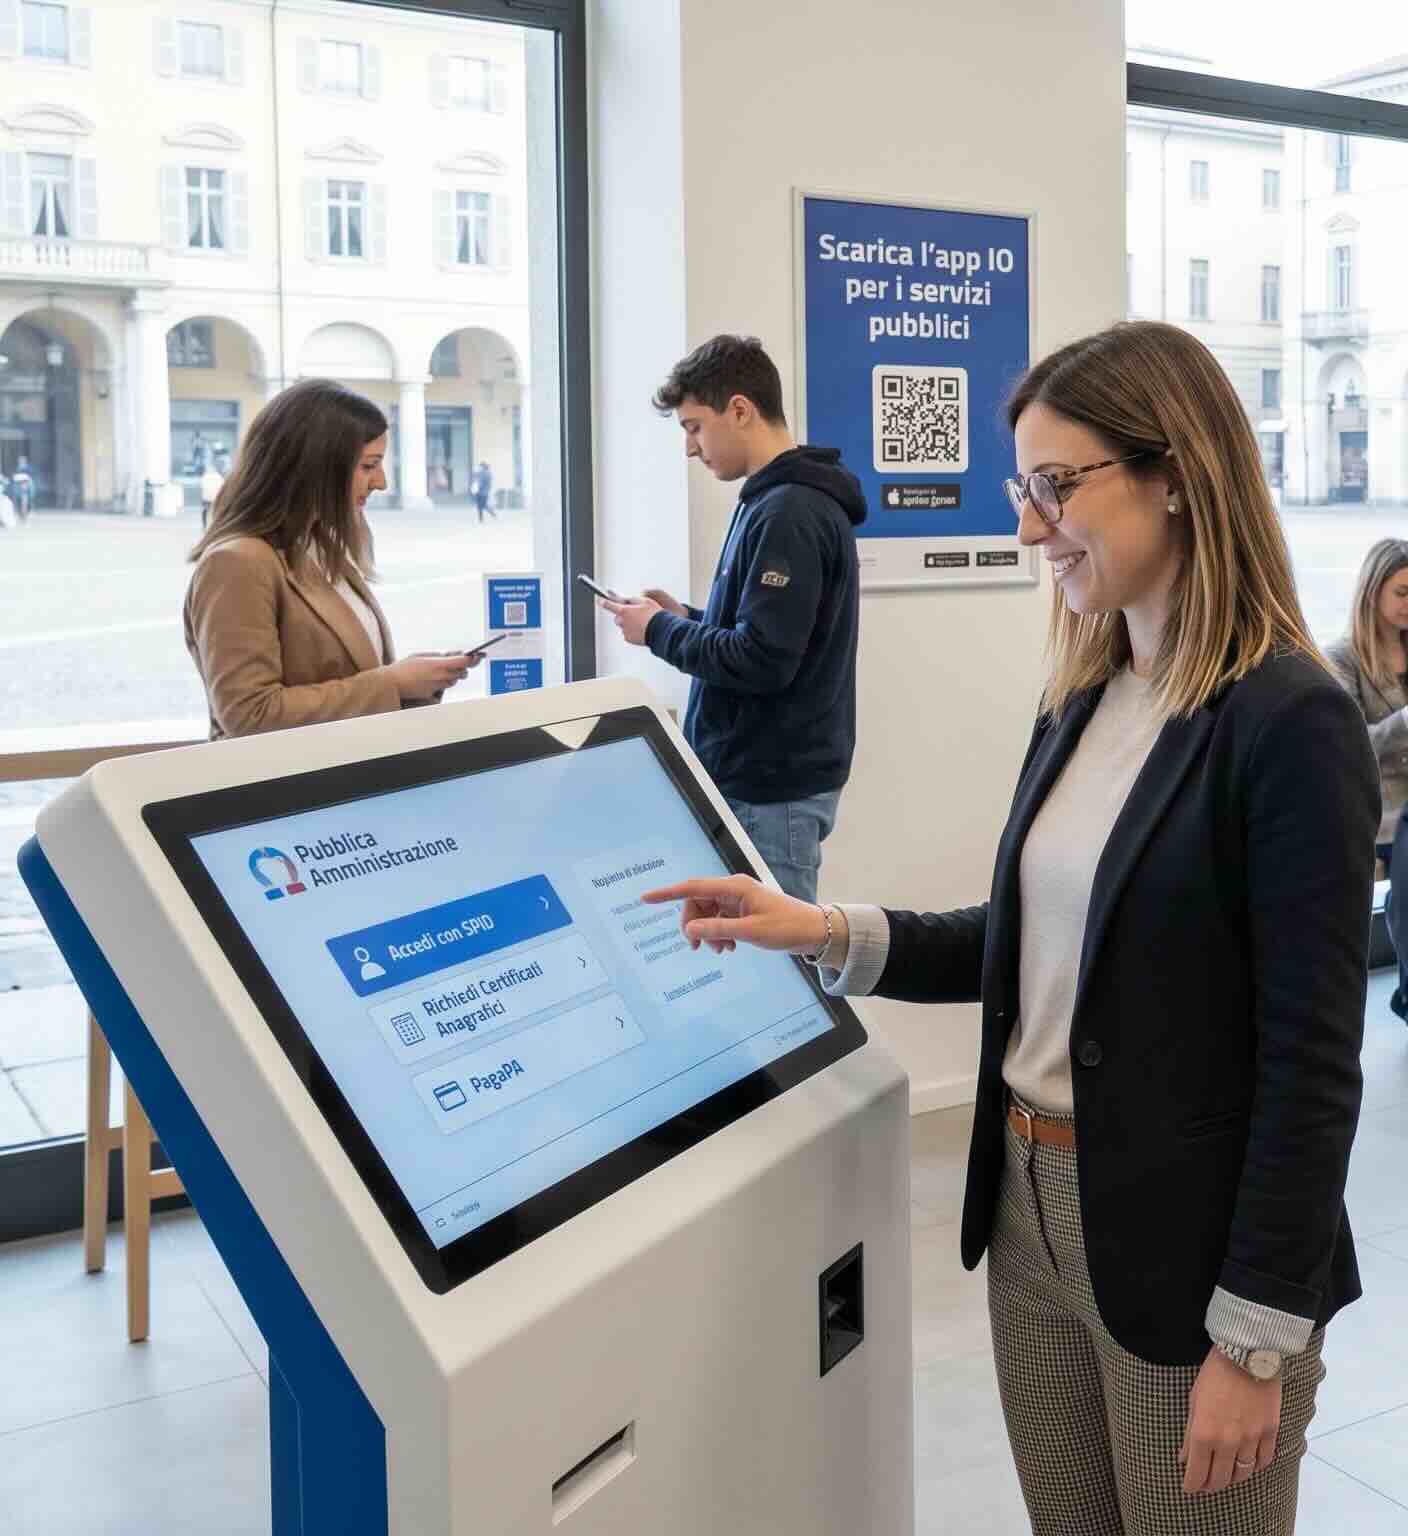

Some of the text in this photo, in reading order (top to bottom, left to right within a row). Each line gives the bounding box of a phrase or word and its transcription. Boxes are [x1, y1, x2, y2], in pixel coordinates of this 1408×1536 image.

[818, 233, 1014, 277] Scarica l'app IO
[846, 275, 991, 306] per i servizi
[869, 311, 969, 342] pubblici
[294, 831, 377, 864] Pubblica
[310, 836, 459, 888] Amministrazione
[387, 913, 495, 961] Accedi con SPID
[422, 961, 543, 1018] Richiedi Certificati
[436, 999, 506, 1039] Anagrafici
[470, 1058, 525, 1094] PagaPA
